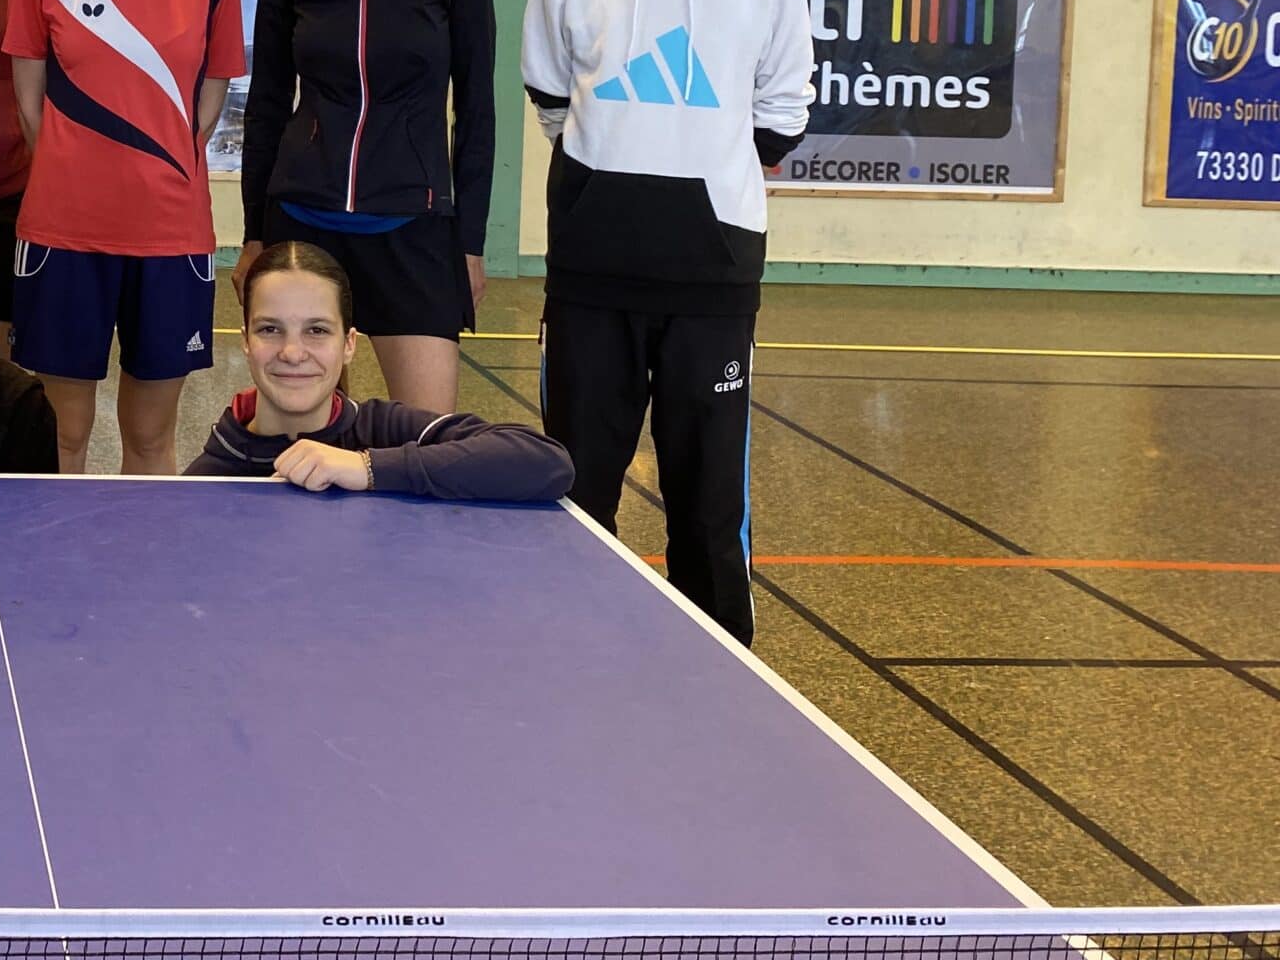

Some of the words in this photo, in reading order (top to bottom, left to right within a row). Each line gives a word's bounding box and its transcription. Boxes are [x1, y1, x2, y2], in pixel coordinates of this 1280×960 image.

[1187, 97, 1222, 120] Vins
[791, 154, 901, 182] DÉCORER
[929, 163, 1010, 185] ISOLER
[1196, 151, 1265, 182] 73330
